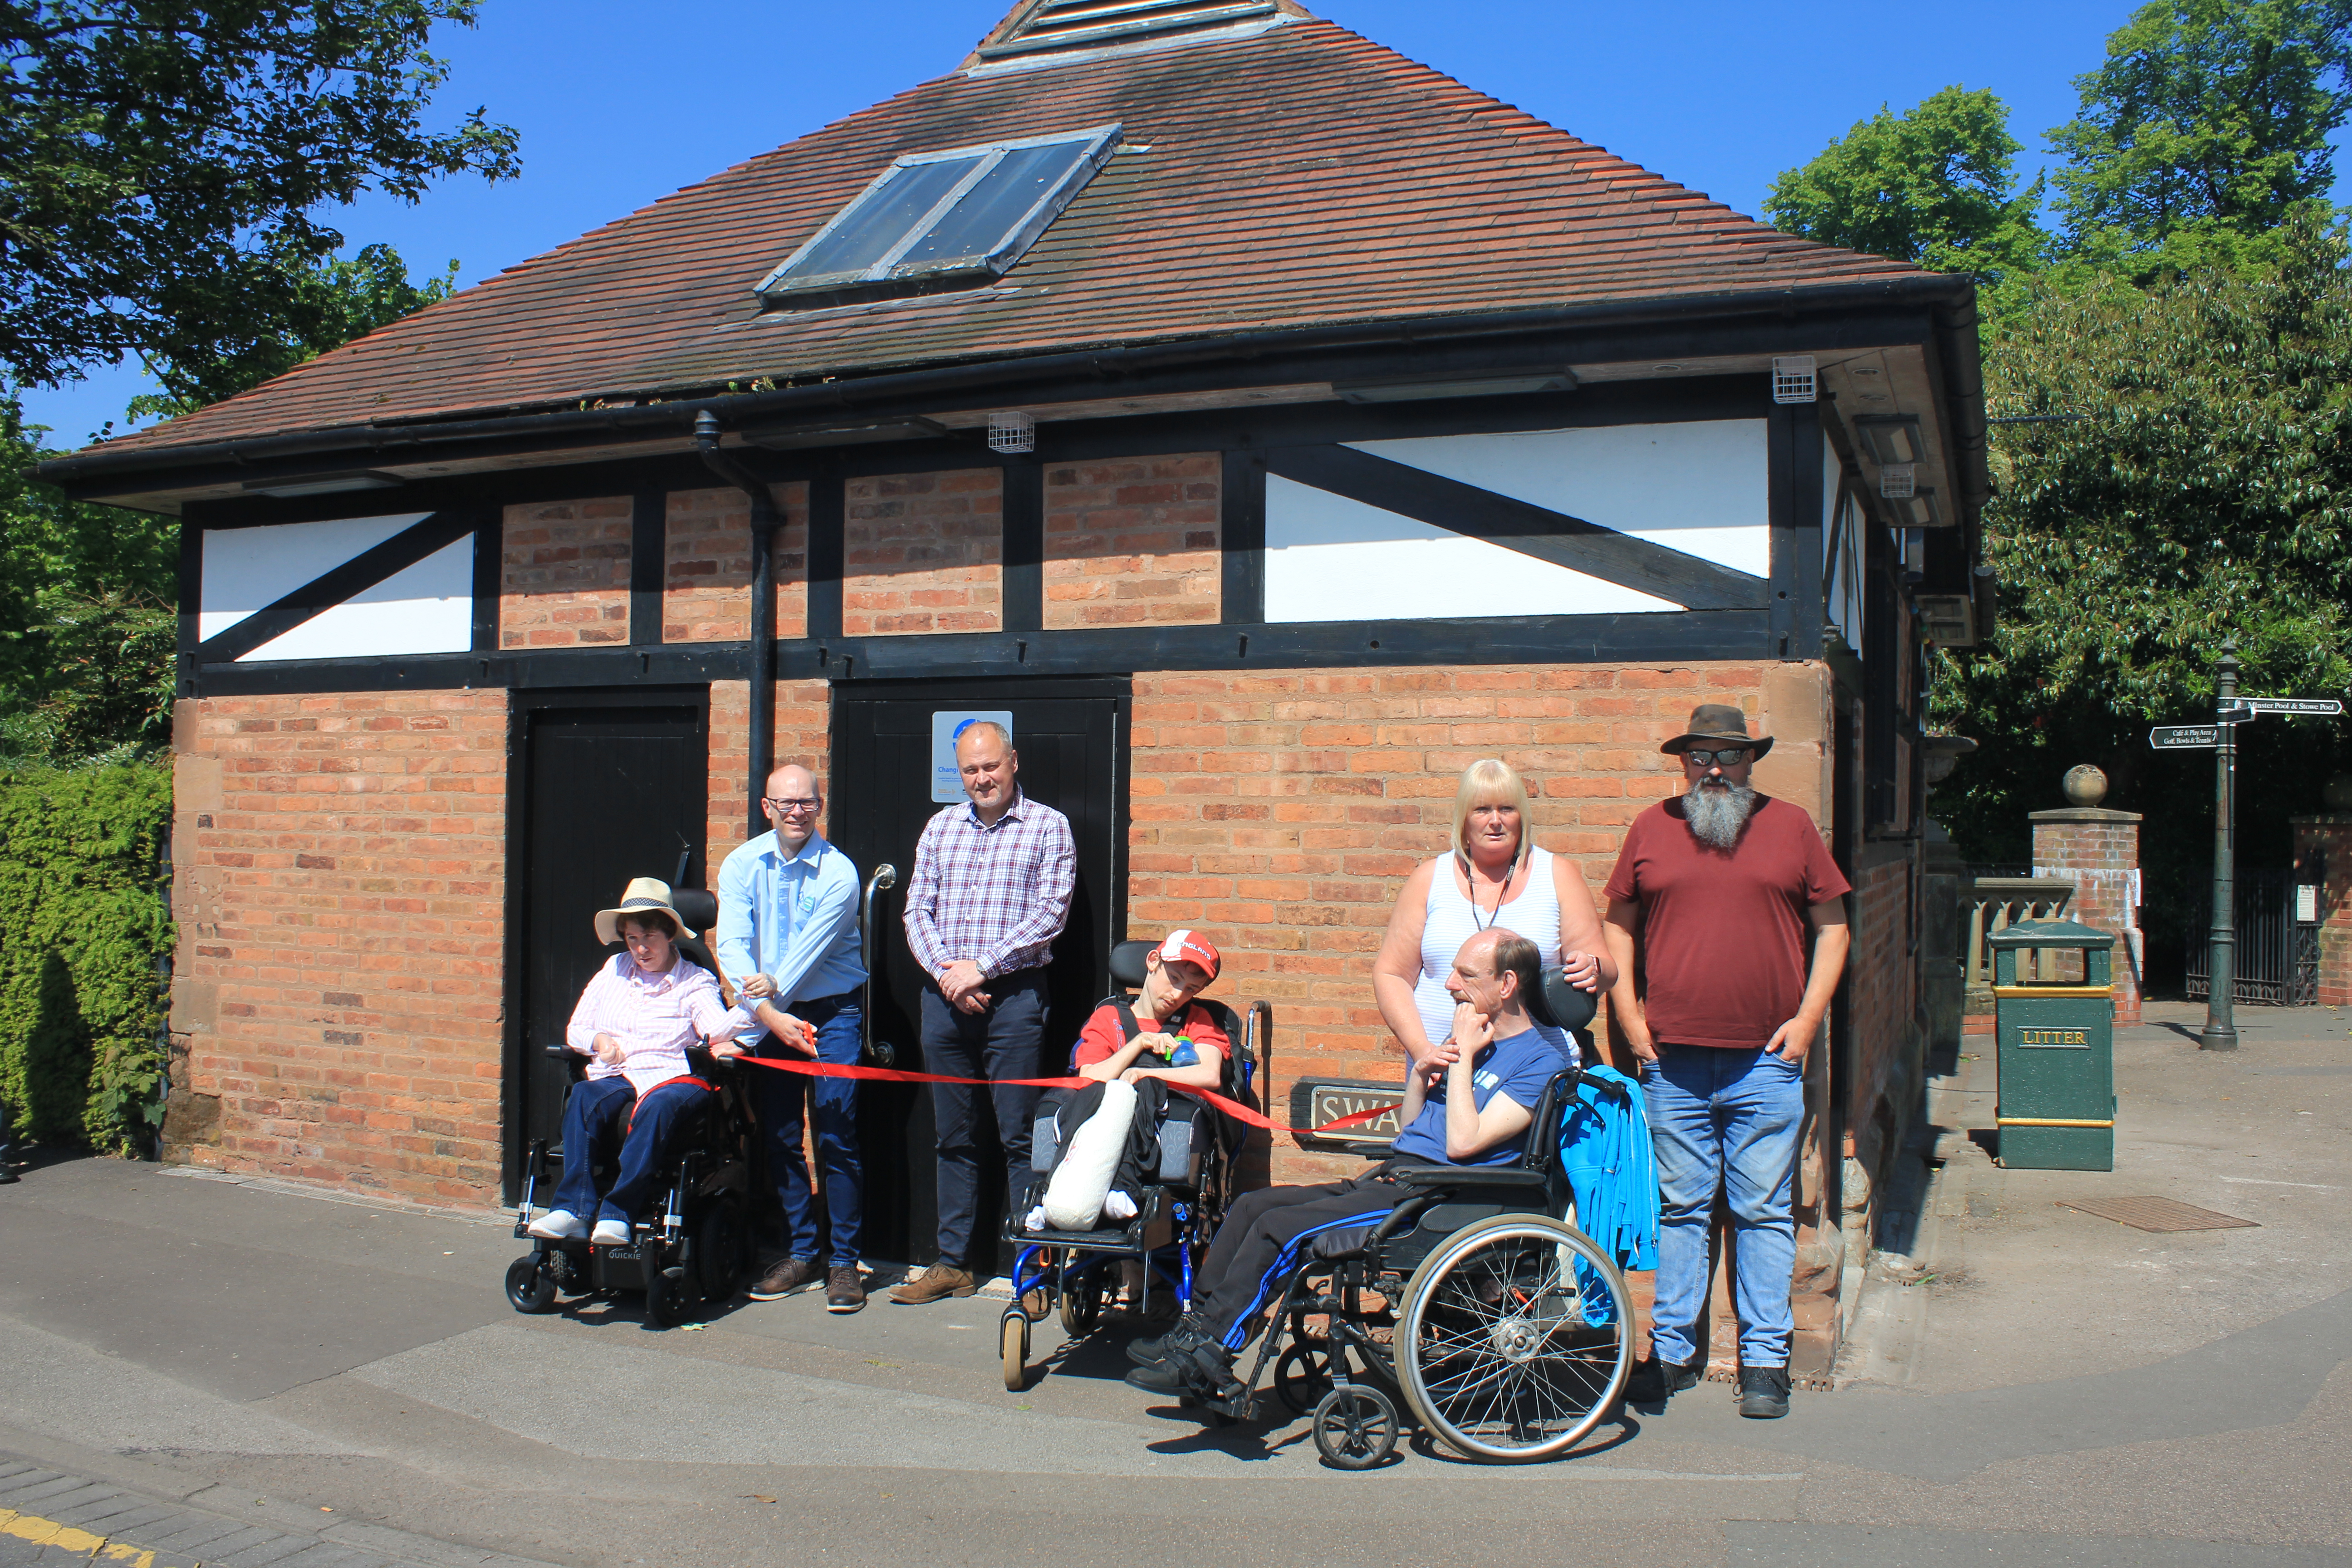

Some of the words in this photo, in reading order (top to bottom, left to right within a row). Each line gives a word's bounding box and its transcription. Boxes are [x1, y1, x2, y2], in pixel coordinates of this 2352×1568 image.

[1177, 941, 1211, 960] ENGLAND
[2022, 1031, 2087, 1044] LITTER
[1321, 1096, 1401, 1133] SWA
[608, 1250, 641, 1260] QUICKIE
